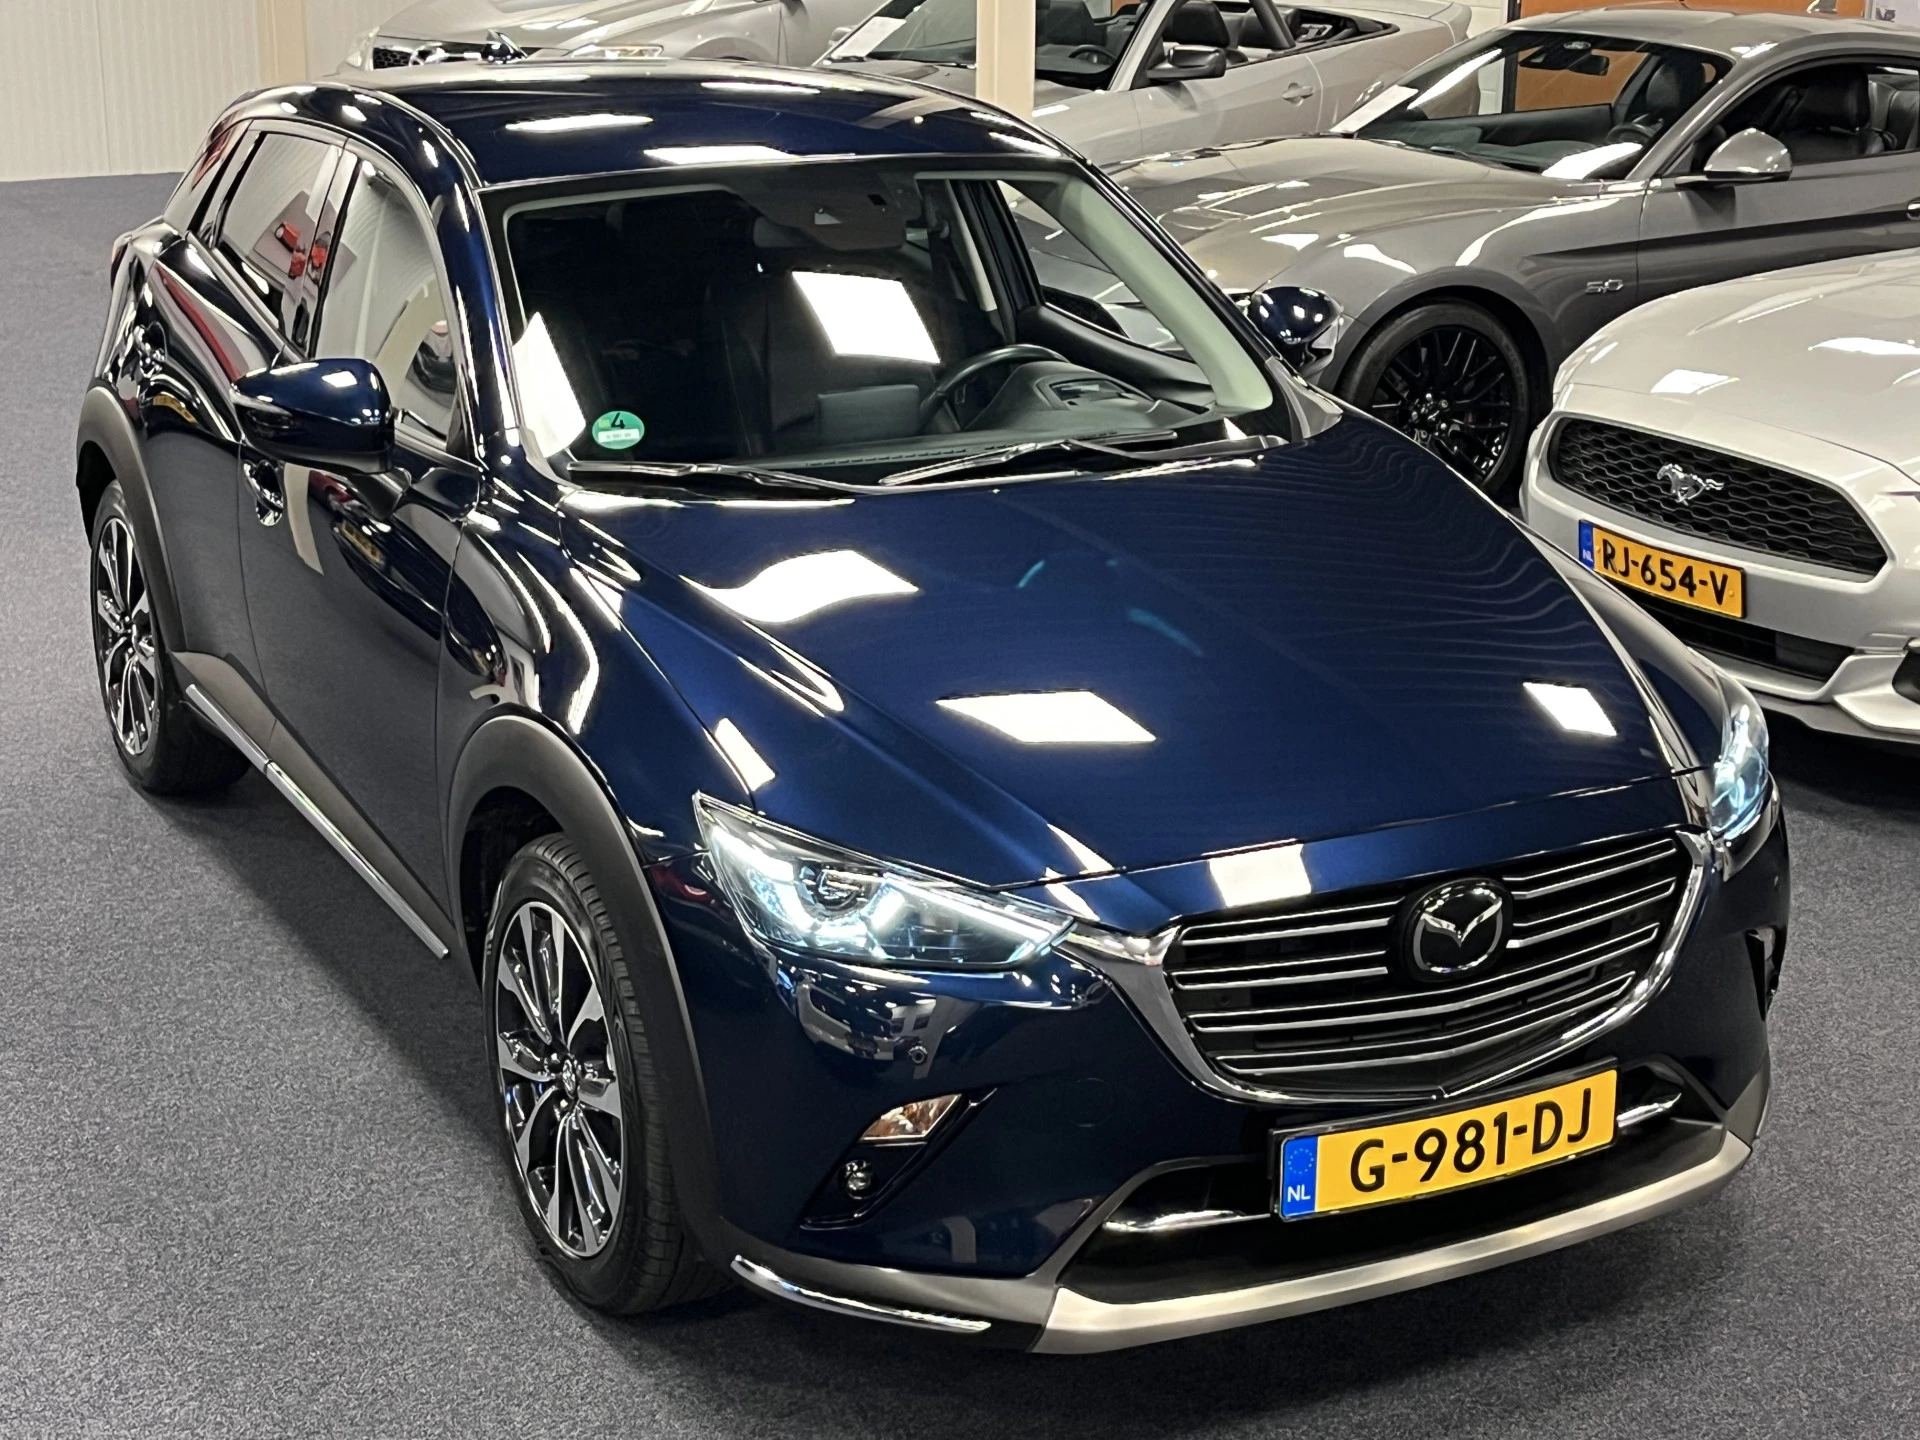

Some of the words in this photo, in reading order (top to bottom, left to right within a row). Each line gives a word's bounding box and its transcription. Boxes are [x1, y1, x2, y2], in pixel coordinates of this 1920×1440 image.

[610, 411, 626, 429] 4
[1602, 538, 1729, 606] RJ-654-V
[1349, 1087, 1592, 1193] G-981-DJ
[1287, 1184, 1311, 1203] NL
